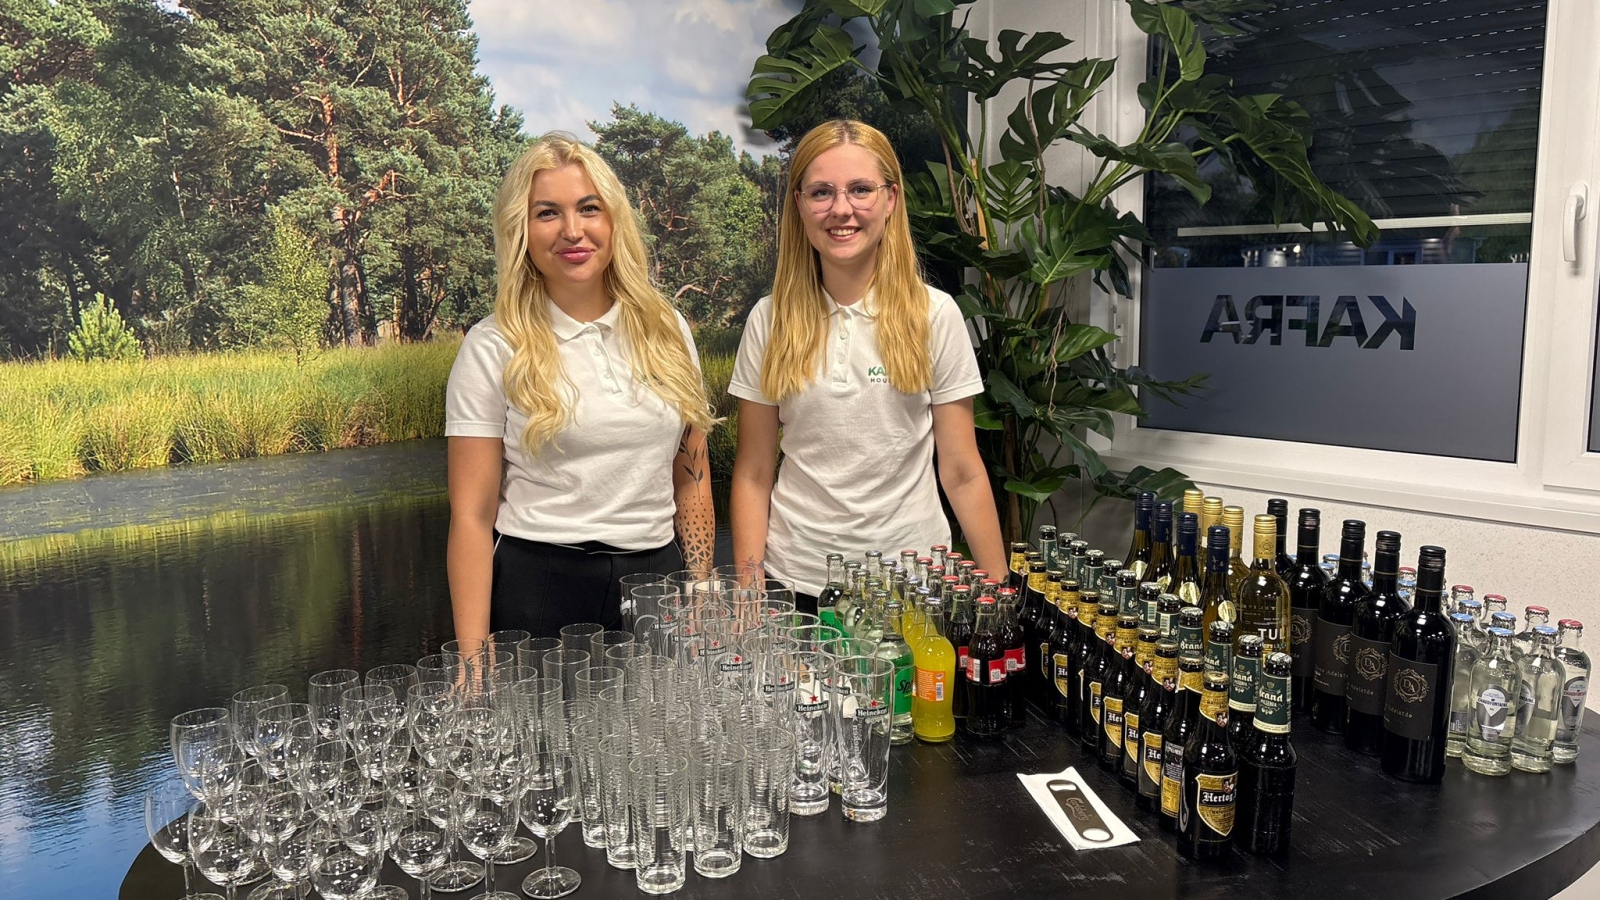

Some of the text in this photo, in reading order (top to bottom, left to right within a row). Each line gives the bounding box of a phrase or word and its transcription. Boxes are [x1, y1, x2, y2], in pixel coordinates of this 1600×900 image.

[868, 366, 886, 376] KA
[798, 702, 828, 712] Heineken
[857, 707, 888, 717] Heineken
